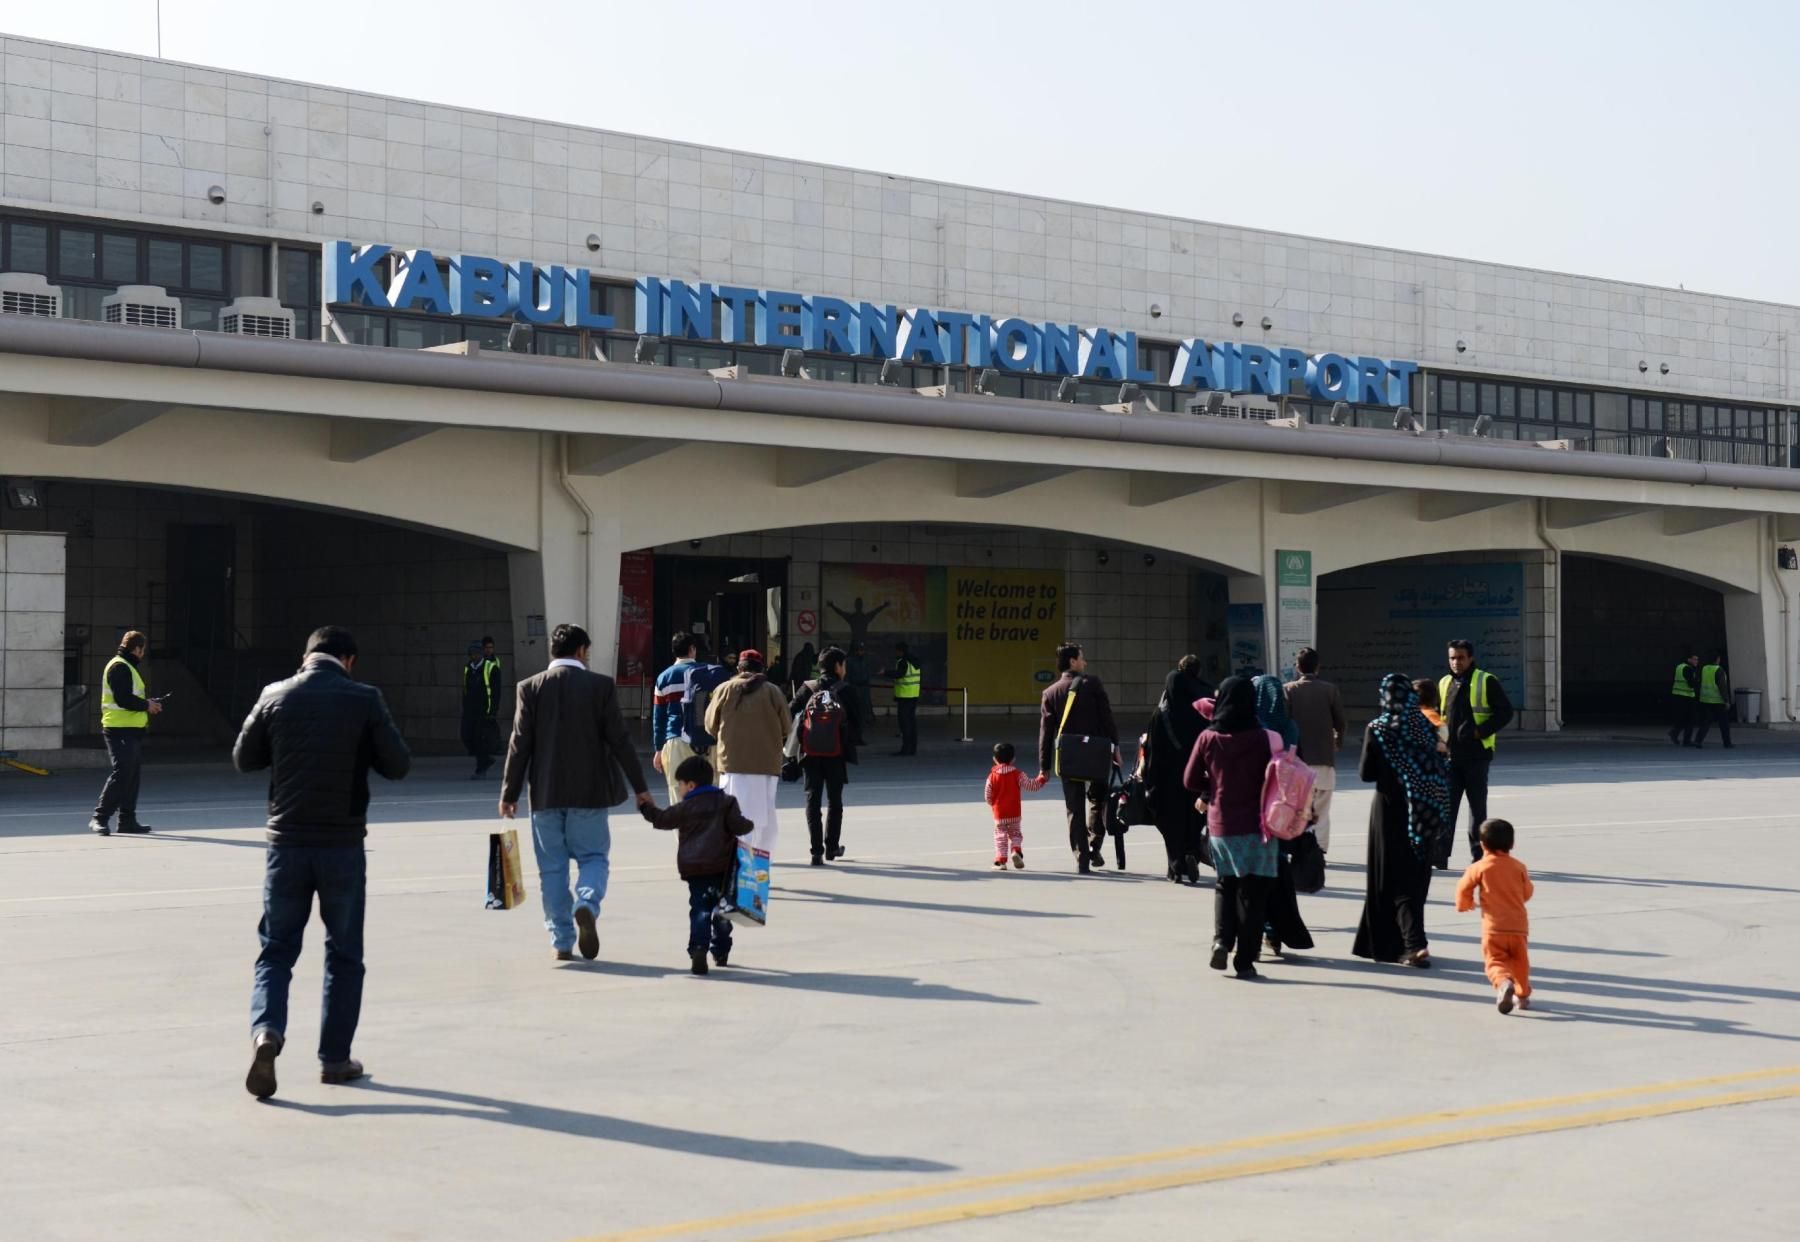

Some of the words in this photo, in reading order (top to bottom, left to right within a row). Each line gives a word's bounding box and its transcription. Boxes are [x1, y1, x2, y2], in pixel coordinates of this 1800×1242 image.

[323, 240, 614, 329] KABUL
[634, 276, 1155, 383] INTERNATIONAL
[1169, 338, 1418, 408] AIRPORT
[956, 579, 1036, 599] Welcome
[1040, 583, 1057, 599] to
[956, 600, 986, 619] the
[991, 601, 1033, 620] land
[1037, 602, 1057, 621] of
[956, 622, 985, 641] the
[990, 622, 1040, 641] brave
